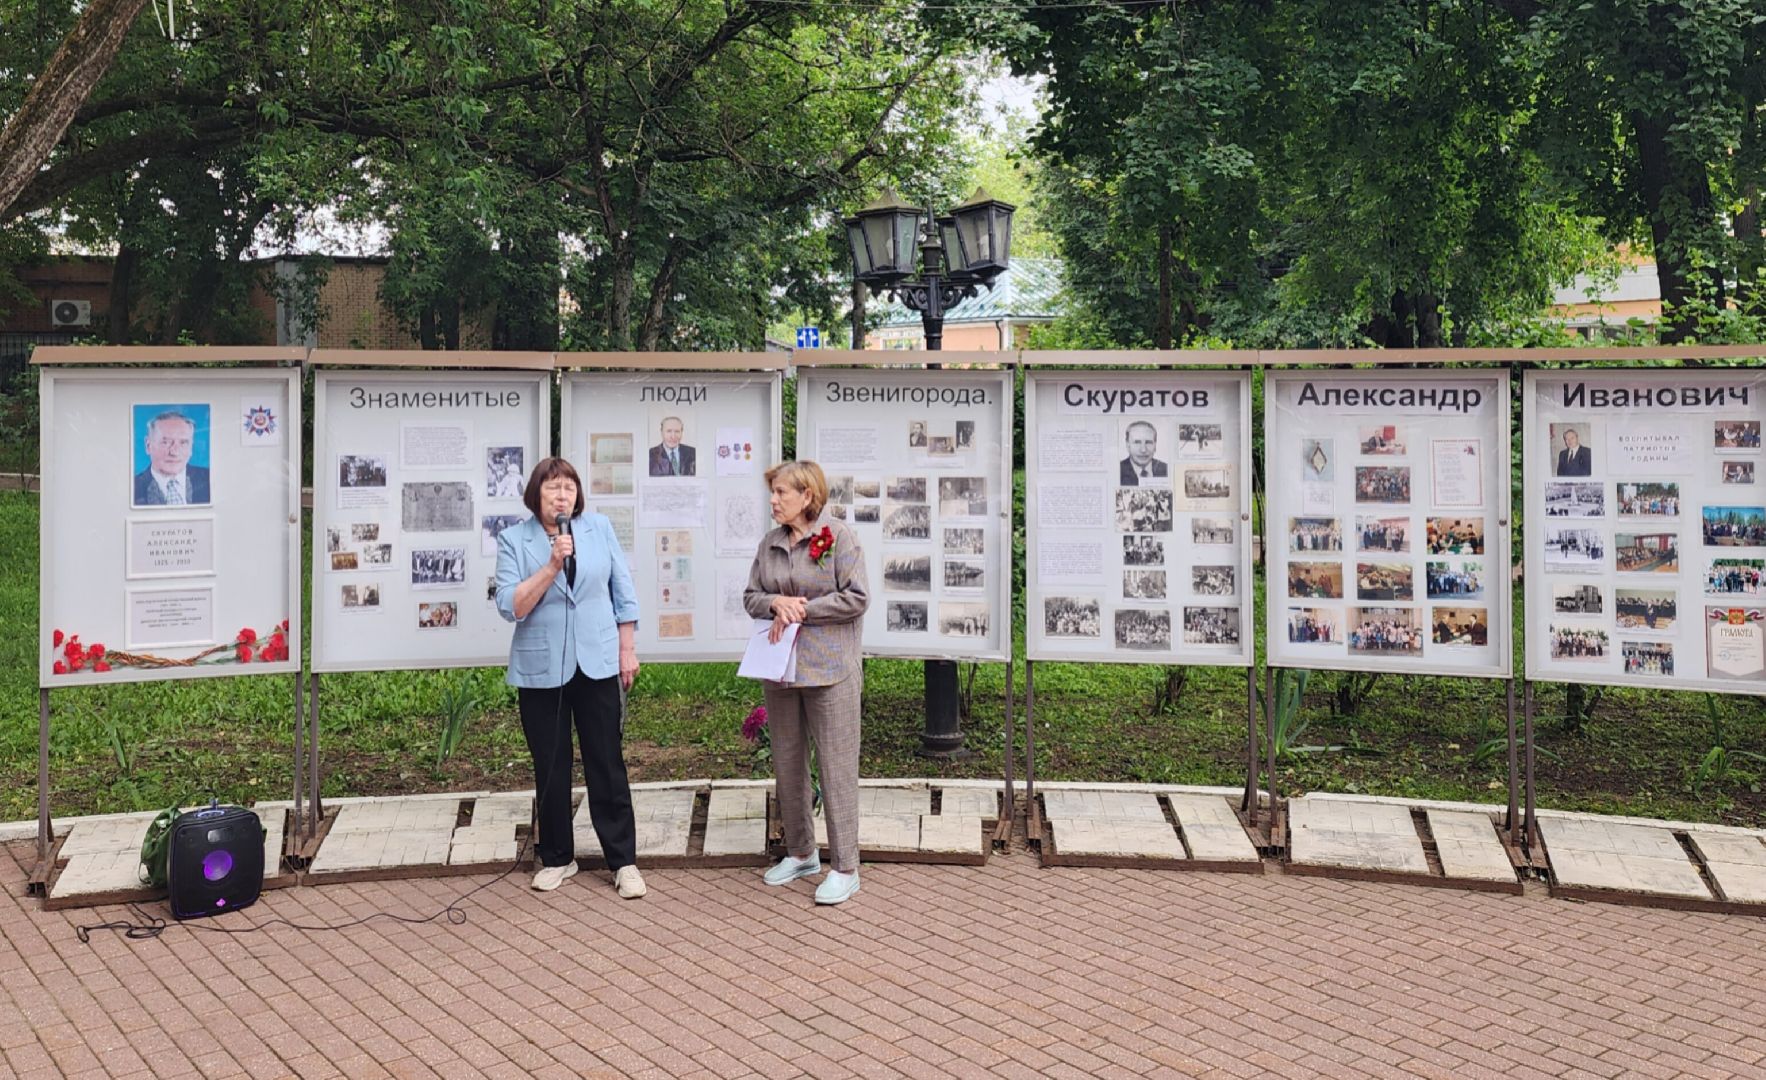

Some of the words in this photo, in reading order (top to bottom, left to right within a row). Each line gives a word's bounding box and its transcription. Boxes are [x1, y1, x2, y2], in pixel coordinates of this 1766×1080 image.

[350, 386, 521, 409] Знаменитые
[639, 386, 707, 406] люди
[826, 381, 993, 408] Звенигорода.
[1064, 383, 1209, 413] Скуратов
[1297, 382, 1482, 413] Александр
[1562, 382, 1749, 408] Иванович
